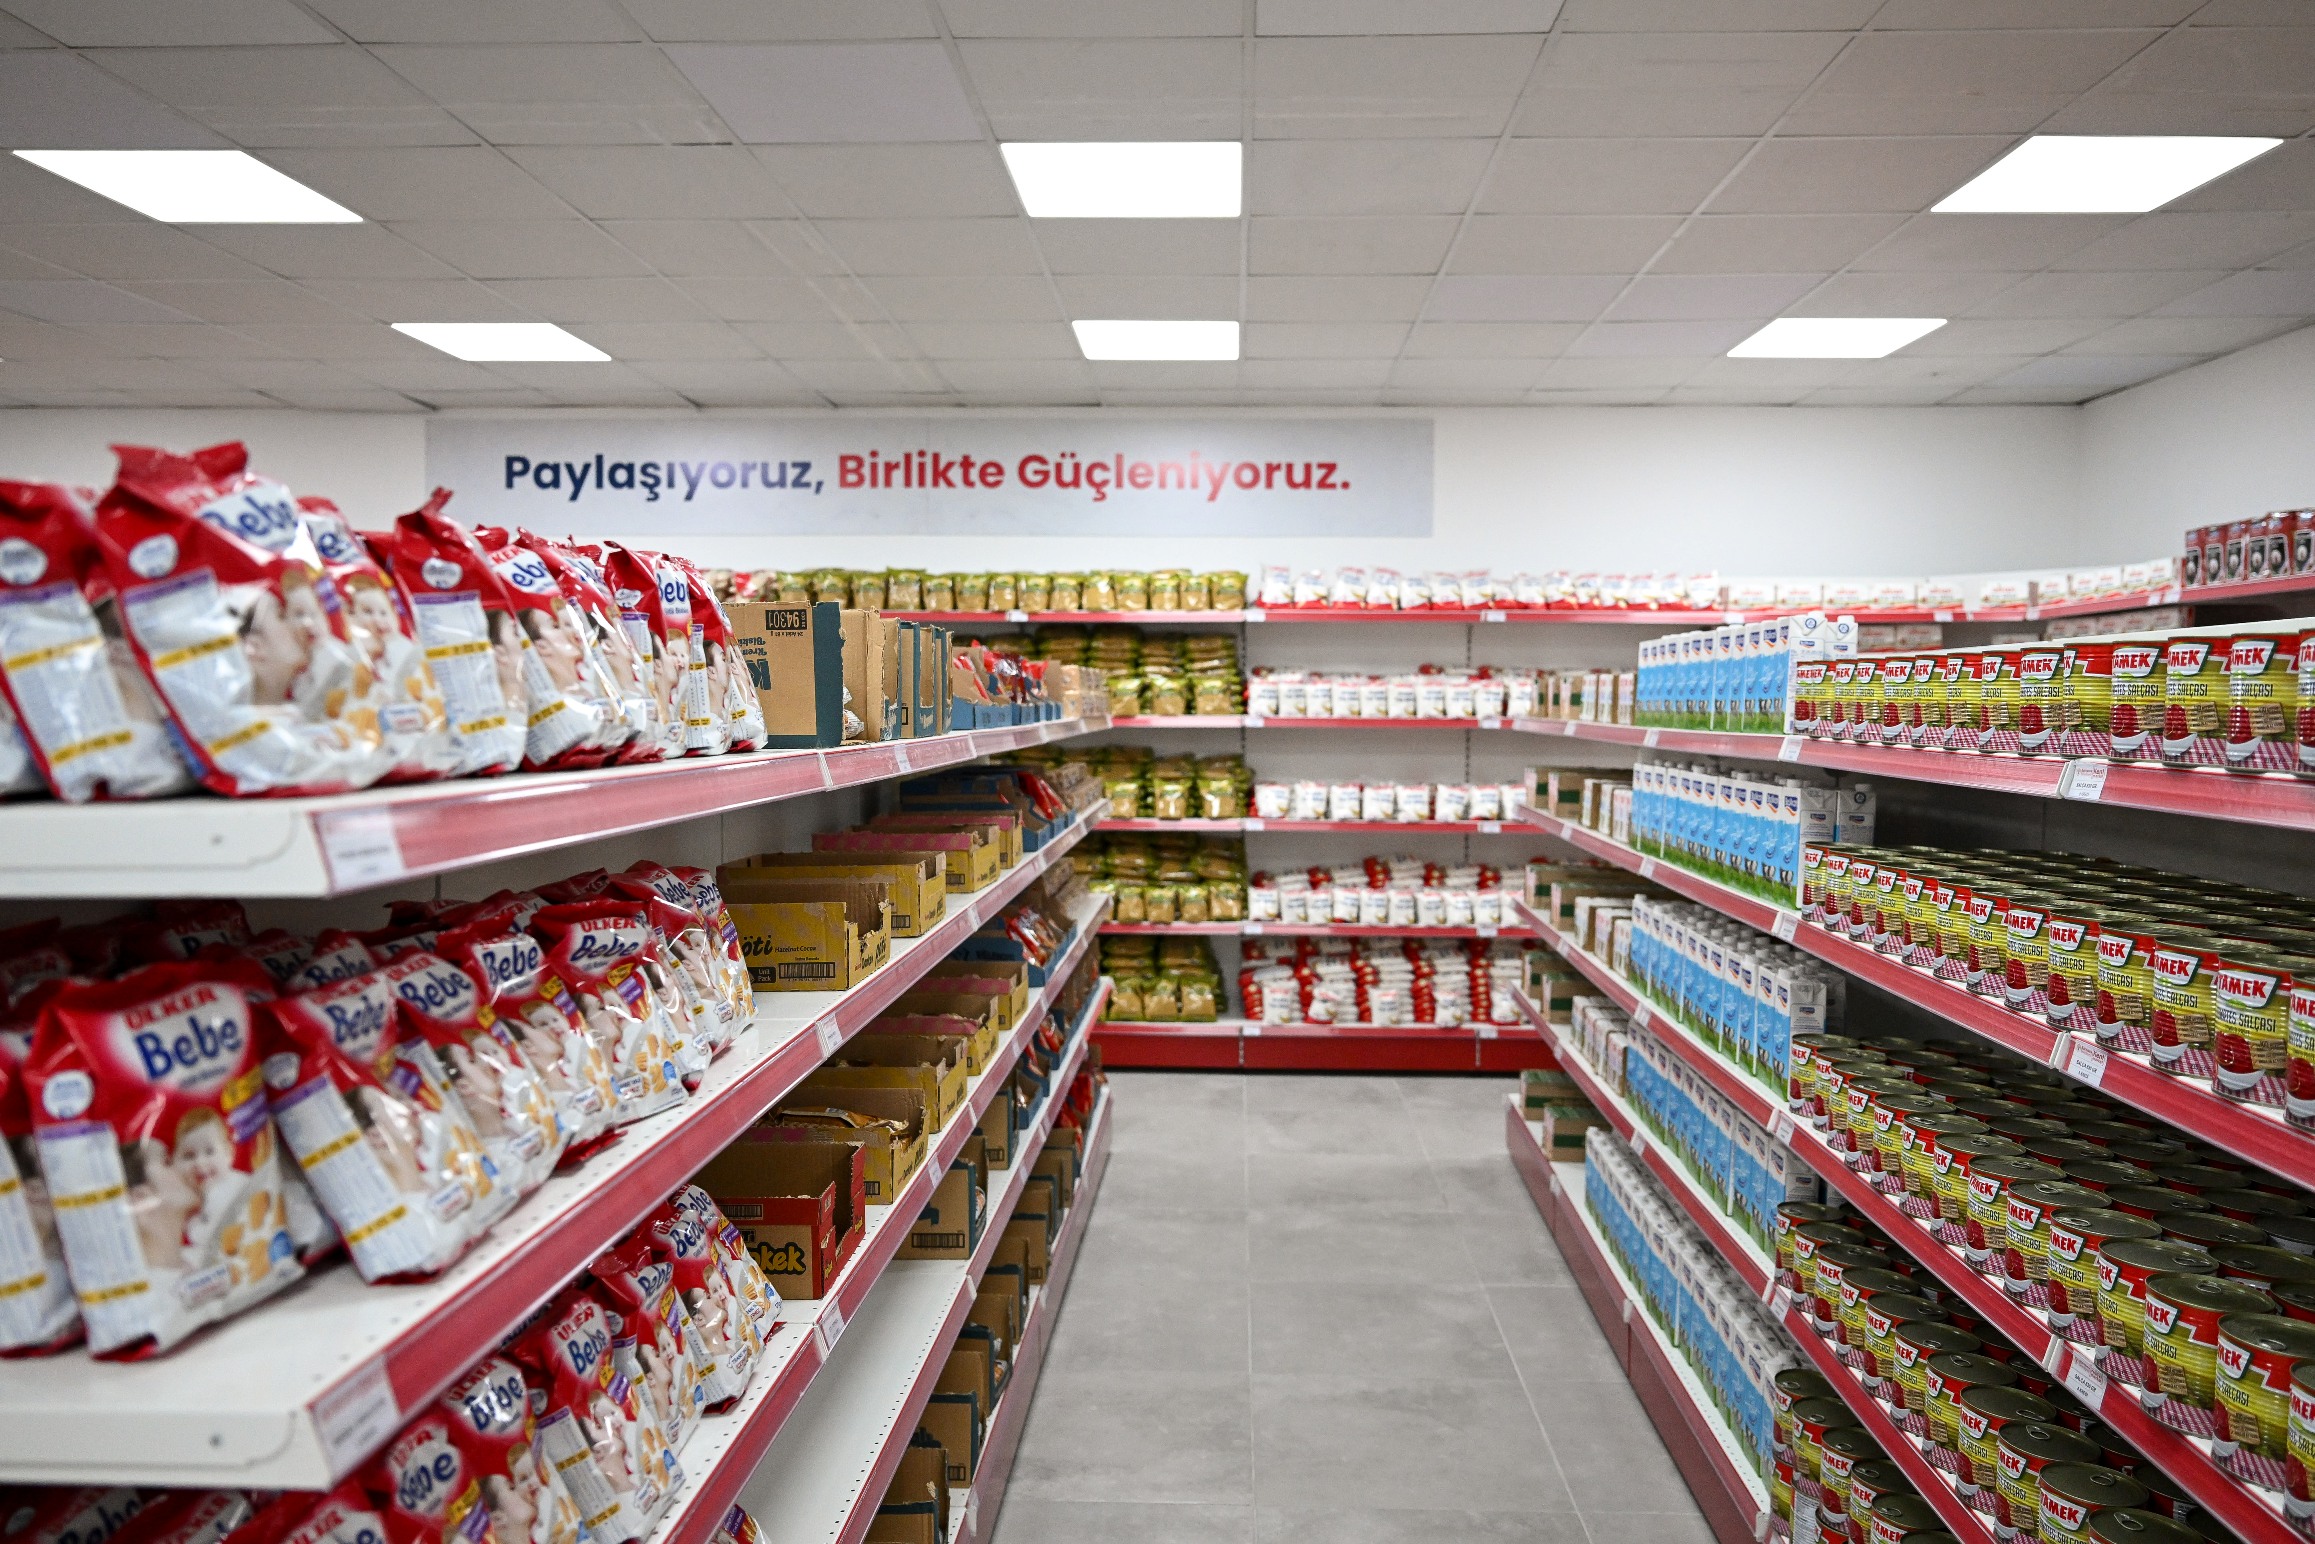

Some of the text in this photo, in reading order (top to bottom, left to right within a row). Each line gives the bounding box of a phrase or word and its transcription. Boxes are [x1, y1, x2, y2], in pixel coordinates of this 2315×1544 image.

[505, 450, 1350, 503] Paylaşıyoruz, Birlikte Güçleniyoruz.
[768, 611, 800, 628] 94301
[2128, 684, 2159, 698] SALÇASI
[2178, 683, 2208, 699] SALÇASI
[2241, 683, 2274, 699] SALÇASI
[654, 878, 691, 904] Bebe
[570, 933, 640, 963] Bebe
[482, 941, 539, 985] Bebe
[400, 970, 472, 1013] Bebe
[2107, 971, 2133, 988] SALÇASI
[2217, 973, 2268, 999] TAMEK
[2166, 990, 2198, 1009] SALÇASI
[2239, 1013, 2276, 1033] SALÇASI
[135, 1014, 243, 1080] Bebe
[752, 1245, 806, 1272] kek
